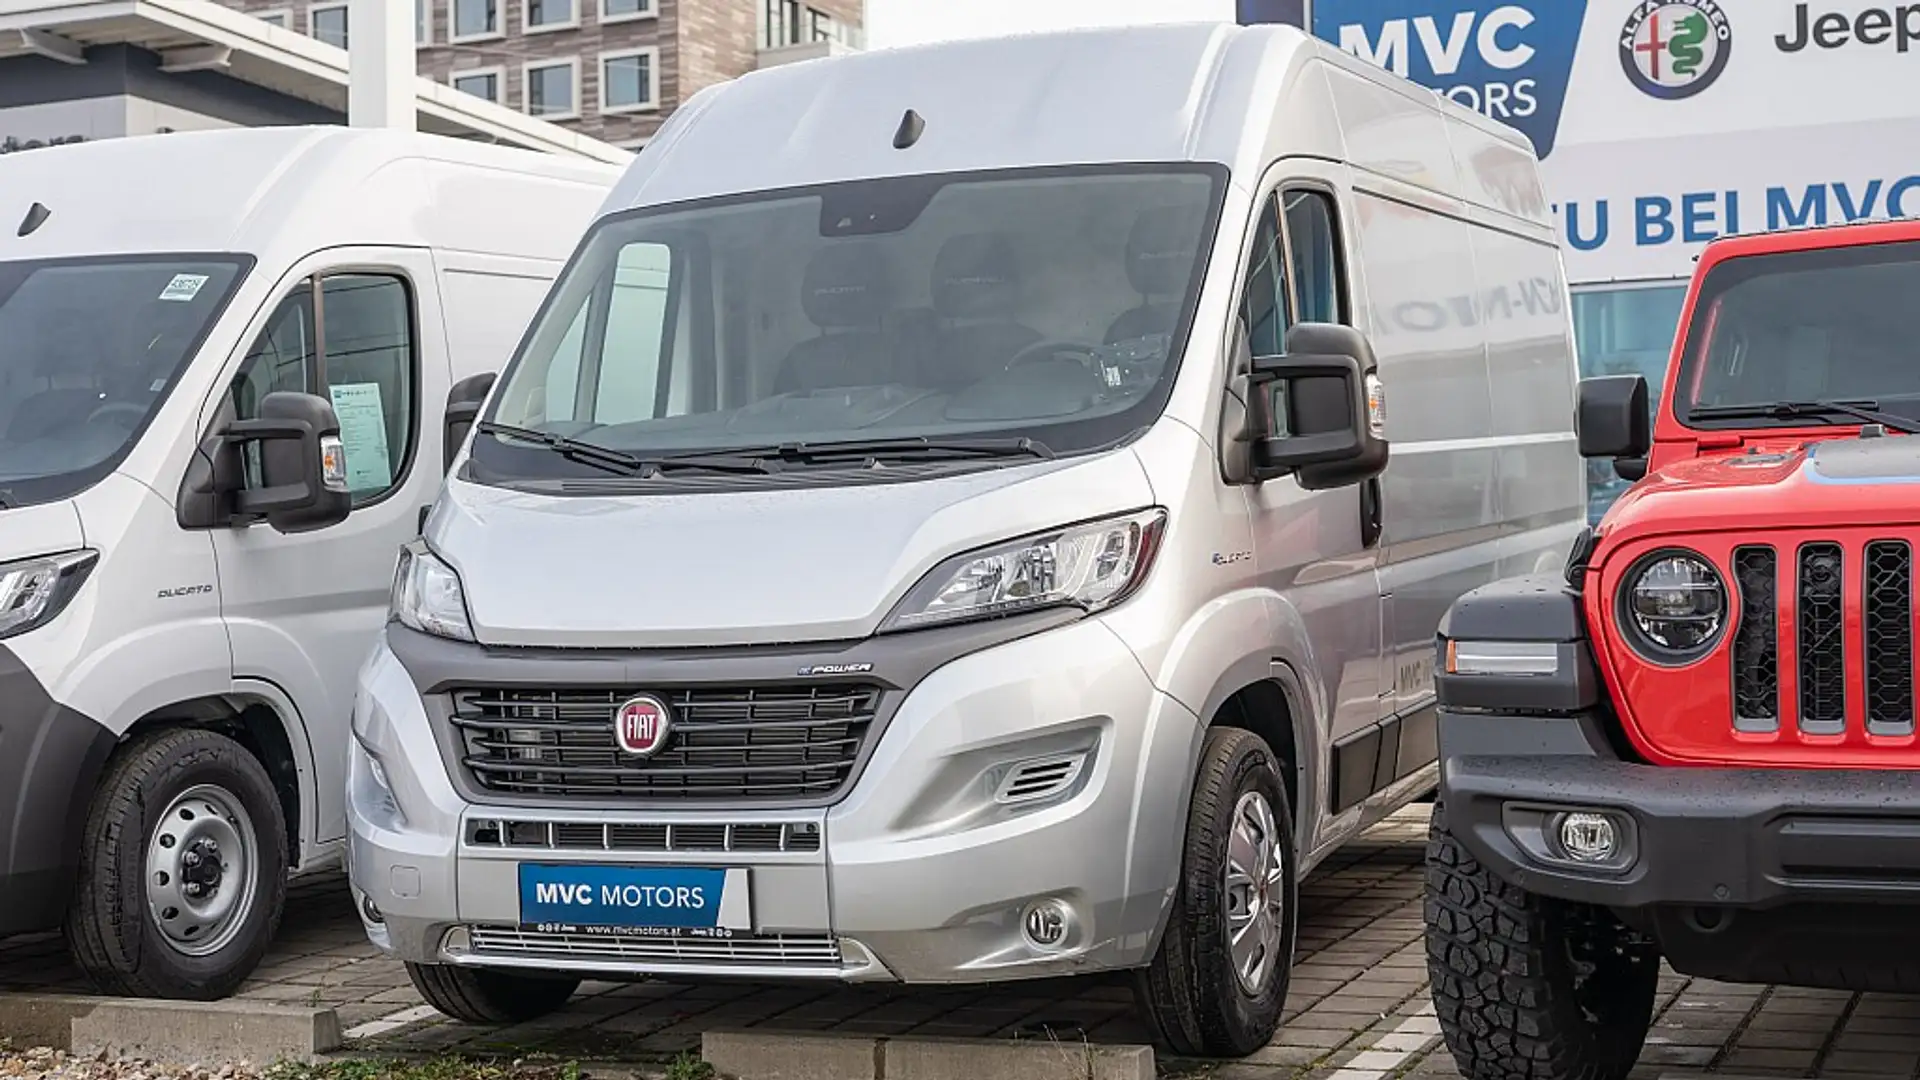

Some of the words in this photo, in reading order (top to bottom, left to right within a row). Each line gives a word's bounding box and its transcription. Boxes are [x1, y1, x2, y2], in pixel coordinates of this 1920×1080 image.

[1339, 5, 1536, 77] MVC
[1774, 3, 1920, 53] Jeep
[1432, 79, 1537, 118] ORS
[1551, 199, 1609, 250] U
[1634, 190, 1739, 245] BEI
[157, 584, 213, 598] DUCATO
[626, 713, 656, 740] FIAT
[535, 883, 593, 905] MVC
[600, 885, 705, 909] MOTORS
